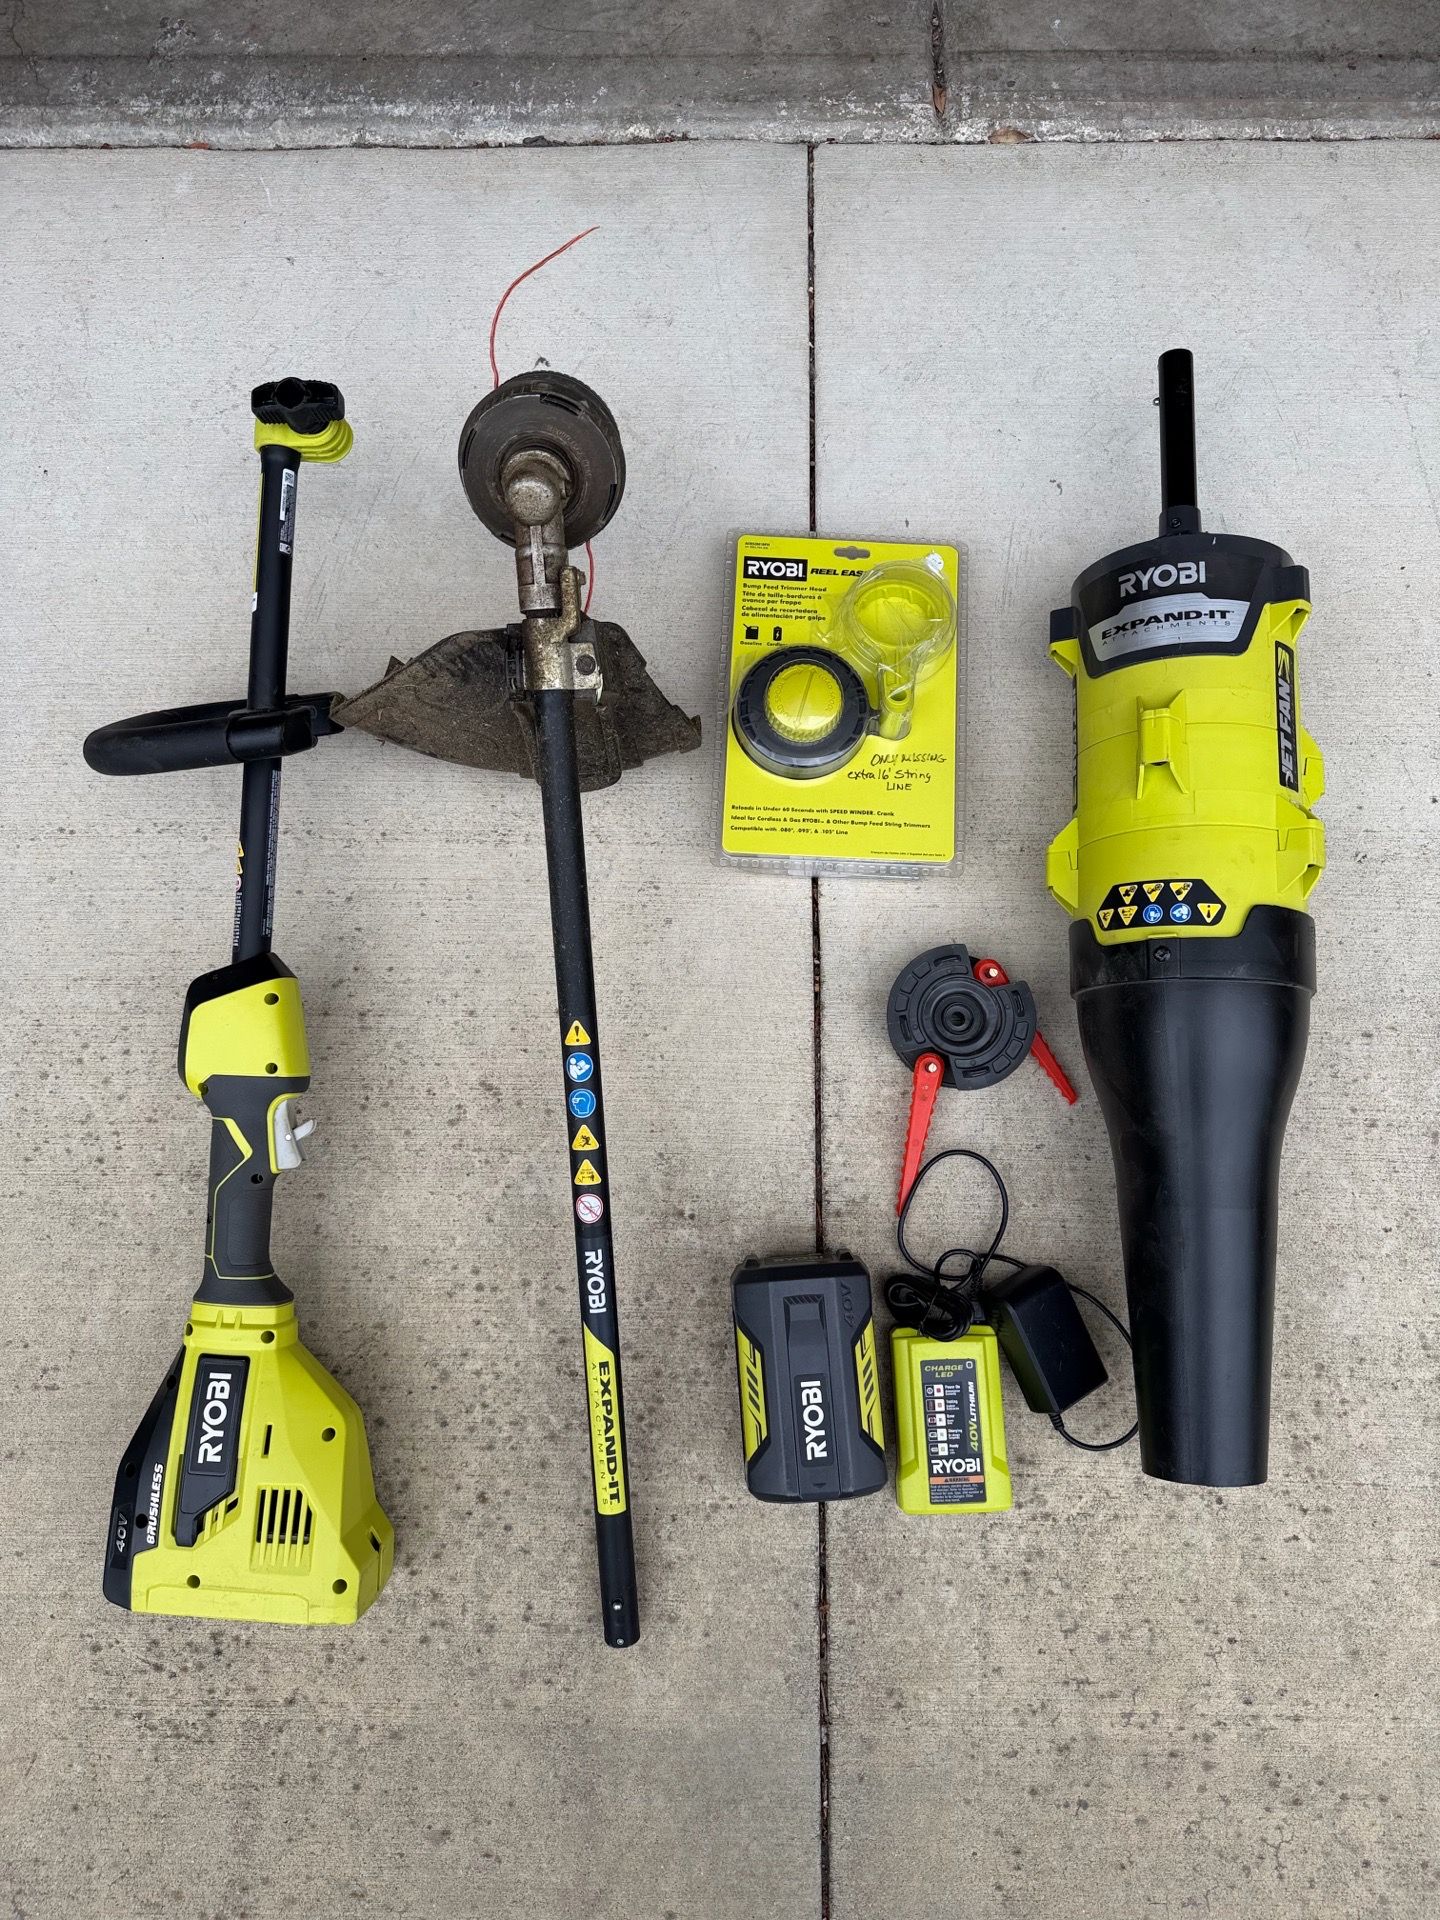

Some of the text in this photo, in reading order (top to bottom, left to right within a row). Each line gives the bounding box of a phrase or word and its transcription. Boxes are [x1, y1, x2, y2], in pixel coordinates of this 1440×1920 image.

[747, 560, 804, 578] RYOBI
[811, 568, 839, 576] REEL
[1118, 561, 1206, 598] RYOBI
[1101, 609, 1232, 640] EXPAND-IT
[1102, 620, 1232, 646] ATTACHMENTS
[1278, 677, 1294, 787] JET FAN
[848, 769, 875, 780] extra
[886, 782, 912, 791] LINE
[584, 1249, 606, 1314] RYOBI
[198, 1372, 232, 1464] RYOBI
[592, 1362, 608, 1505] ATTACHMENTS
[599, 1361, 620, 1504] EXPAND-IT
[801, 1380, 828, 1460] RYOBI
[931, 1458, 980, 1474] RYOBI
[146, 1463, 163, 1544] BRUSHLESS
[116, 1513, 128, 1552] 40V
